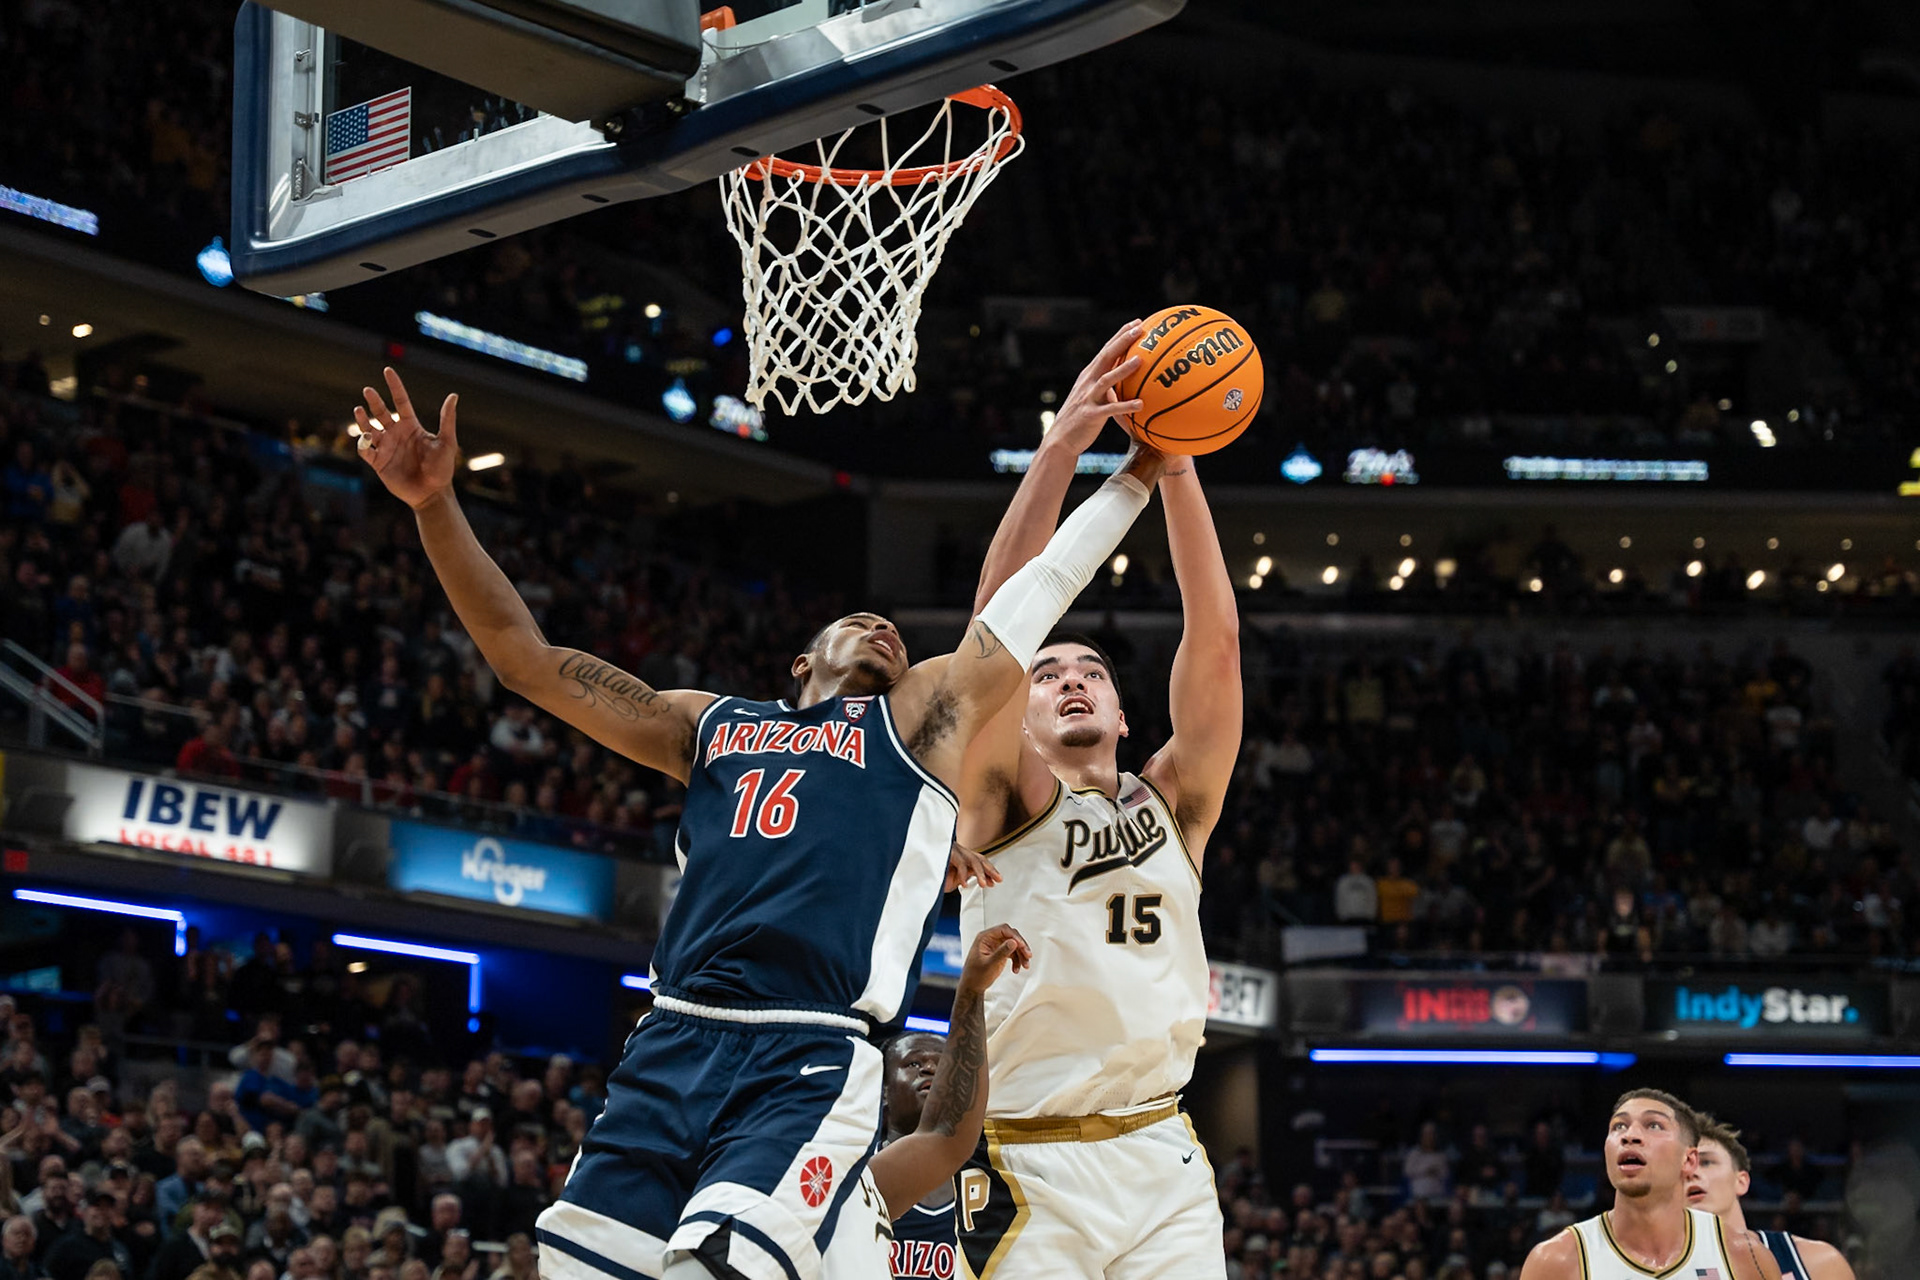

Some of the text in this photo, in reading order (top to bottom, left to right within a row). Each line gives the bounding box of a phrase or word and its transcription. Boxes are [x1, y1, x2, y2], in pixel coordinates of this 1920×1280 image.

[1139, 307, 1202, 352] NCAA
[1155, 327, 1245, 388] Wilson
[704, 720, 866, 769] ARIZONA
[122, 779, 282, 840] IBEW
[729, 768, 806, 839] 16
[119, 828, 213, 858] LOCAL
[461, 837, 546, 906] Kroger
[1105, 893, 1163, 945] 15
[1675, 984, 1860, 1029] IndyStar.
[960, 1167, 991, 1232] P
